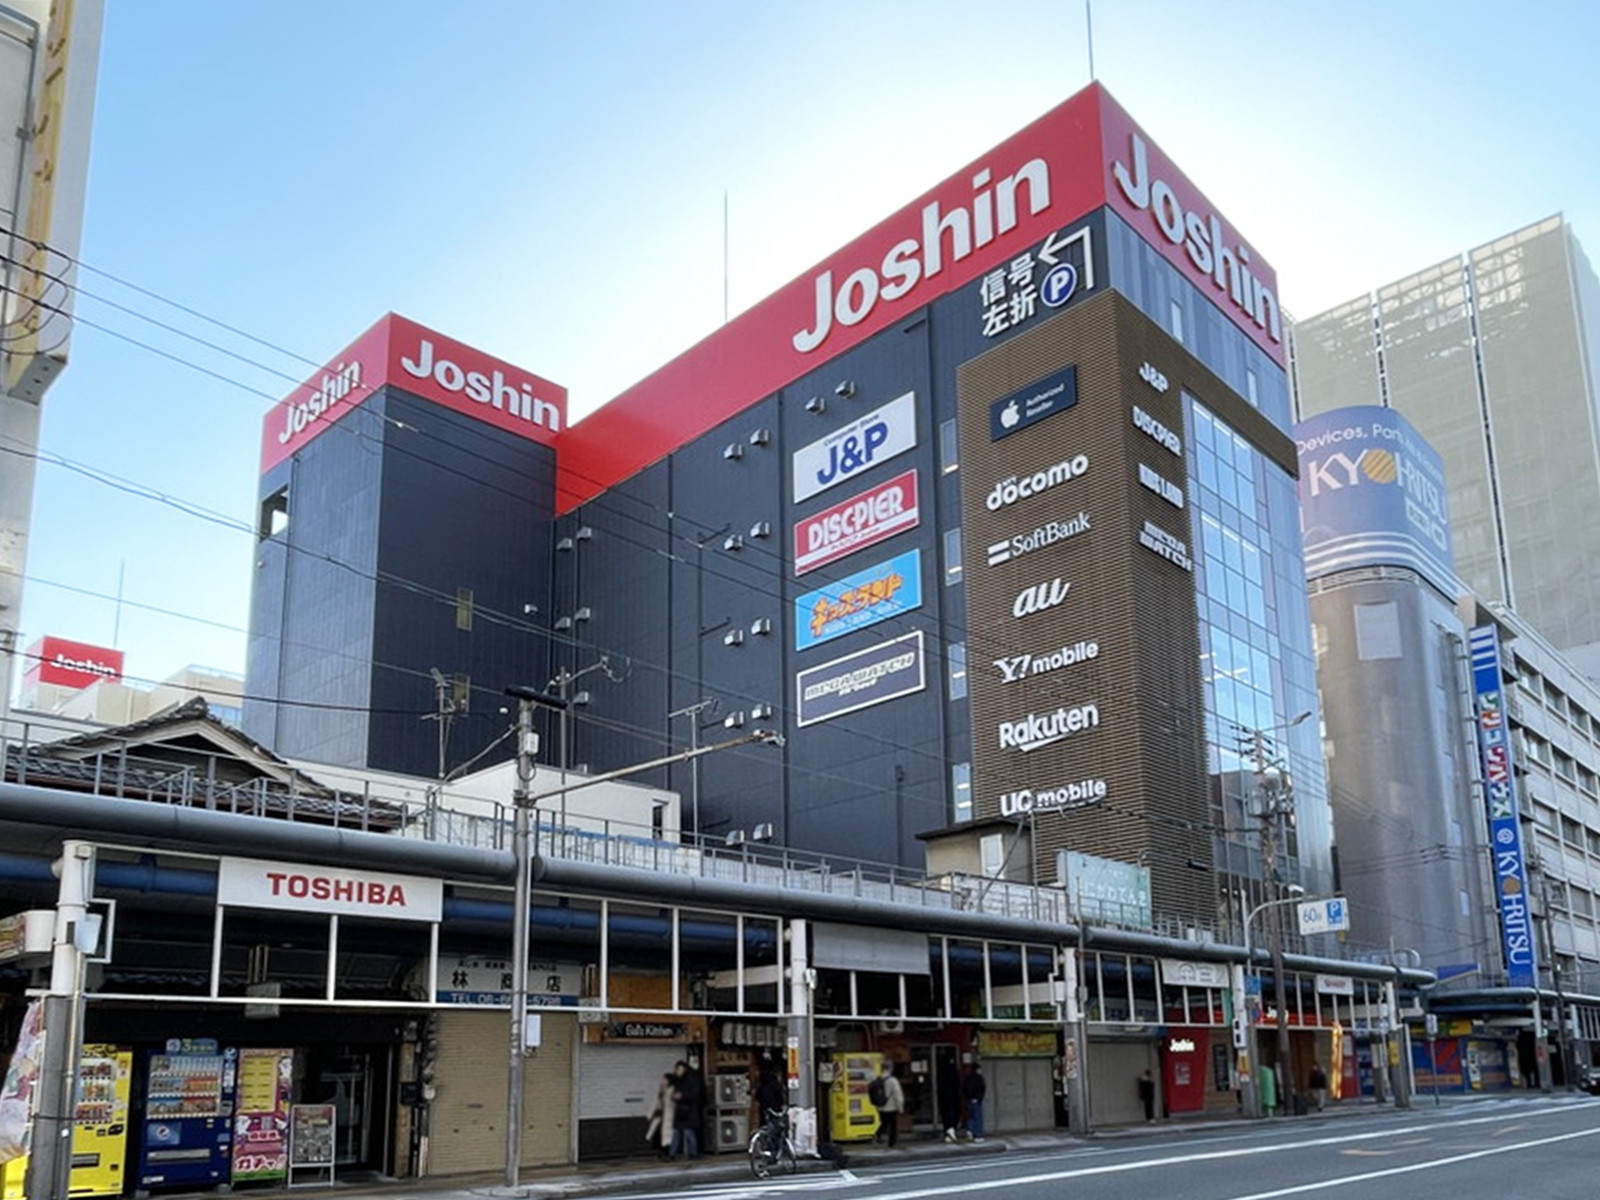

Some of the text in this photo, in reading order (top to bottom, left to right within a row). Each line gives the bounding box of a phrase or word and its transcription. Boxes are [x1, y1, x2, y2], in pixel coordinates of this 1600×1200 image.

[792, 158, 1050, 353] Joshin
[1114, 132, 1280, 344] Joshin
[979, 252, 1036, 306] 信号
[981, 285, 1038, 337] 左折
[278, 358, 361, 444] Joshin
[401, 339, 560, 432] Joshin
[817, 421, 889, 485] J&P
[986, 454, 1089, 510] docomo
[1012, 512, 1091, 557] SoftBank
[1013, 577, 1071, 619] au
[51, 653, 117, 678] Joshin
[998, 704, 1100, 750] Rakuten
[1036, 779, 1107, 808] mobile
[267, 872, 406, 907] TOSHIBA
